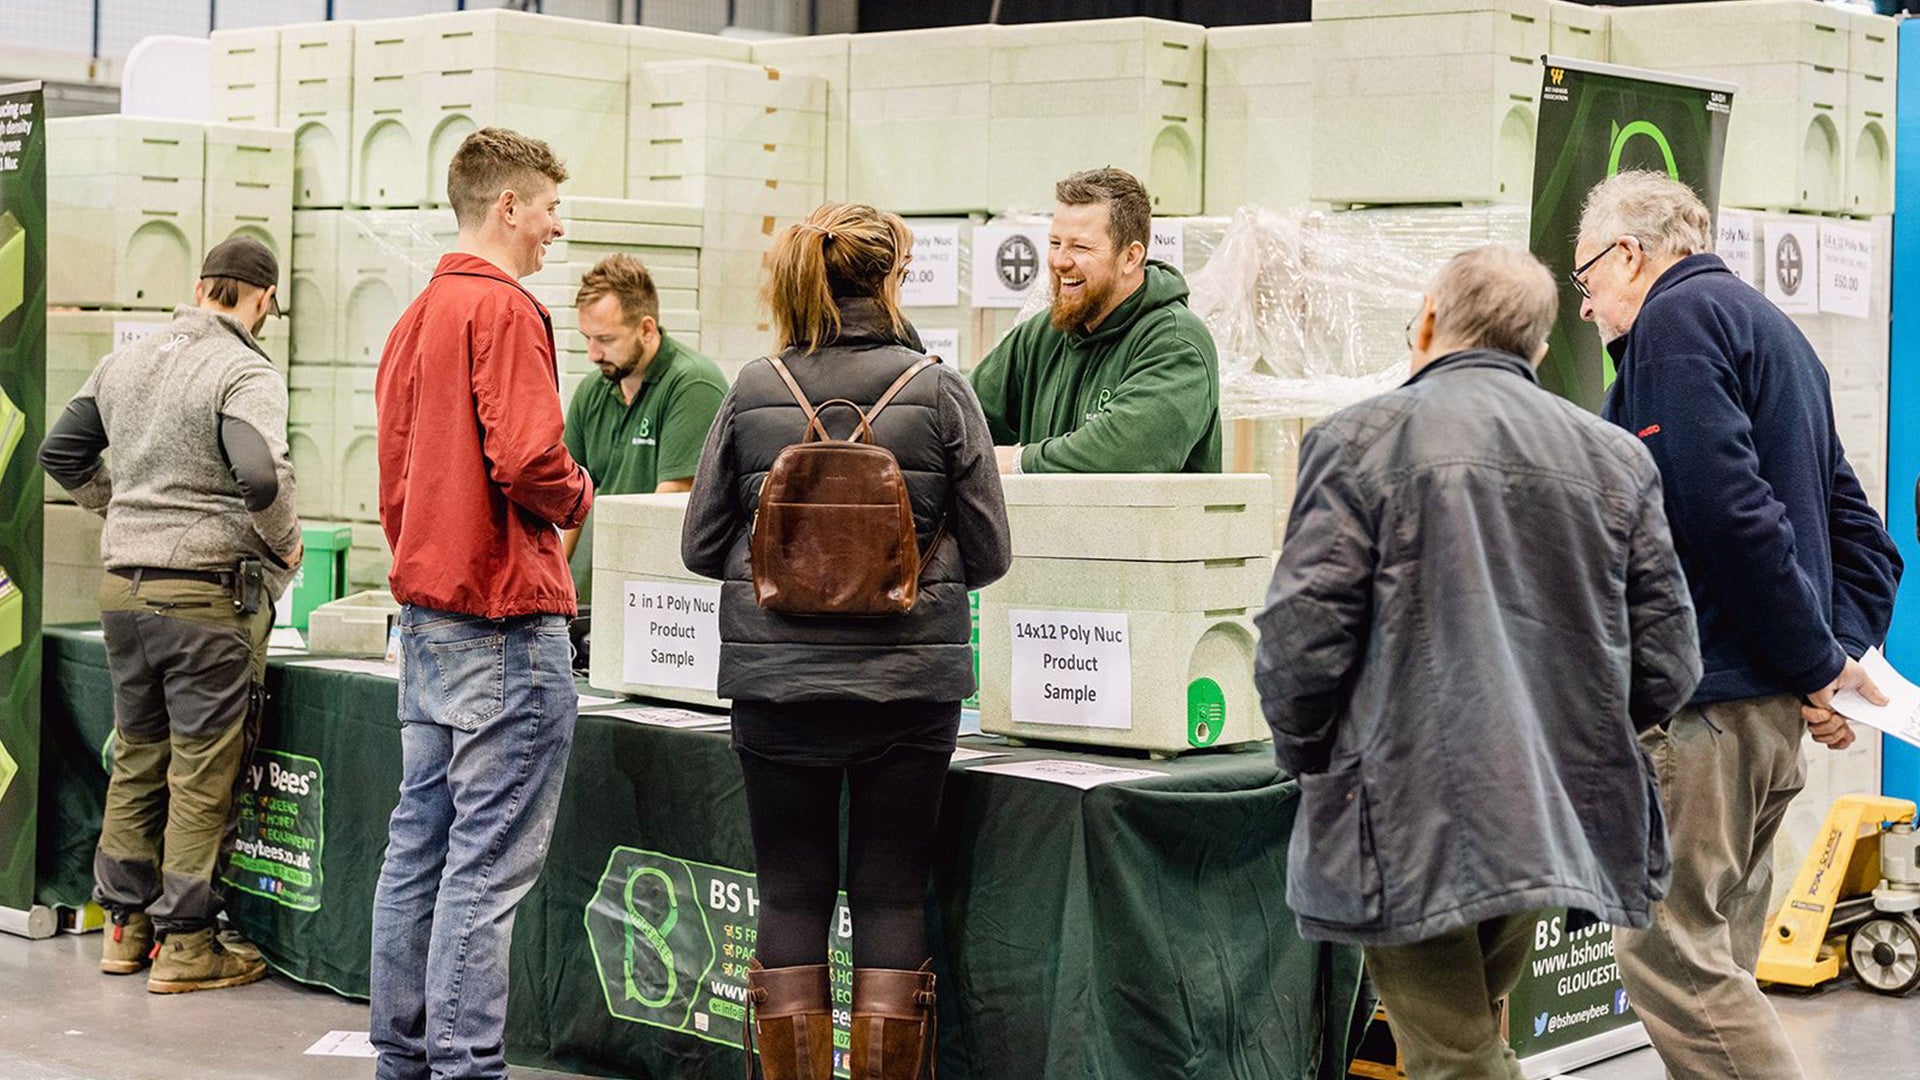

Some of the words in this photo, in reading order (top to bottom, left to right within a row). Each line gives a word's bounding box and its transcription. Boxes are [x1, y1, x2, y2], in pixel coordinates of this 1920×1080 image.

[20, 103, 33, 115] our
[6, 119, 32, 136] density
[4, 156, 18, 170] Nuc
[934, 236, 952, 246] Nuc
[1154, 234, 1175, 245] Nuc
[906, 270, 934, 283] 0.00
[629, 592, 636, 607] 2
[642, 593, 653, 608] in
[657, 594, 663, 609] 1
[667, 595, 691, 614] Poly
[693, 597, 715, 613] Nuc
[650, 621, 695, 639] Product
[1016, 622, 1057, 640] 14x12
[1060, 624, 1090, 645] Poly
[1094, 625, 1122, 643] Nuc
[651, 648, 695, 668] Sample
[1043, 653, 1098, 672] Product
[1044, 682, 1097, 705] Sample
[710, 878, 741, 913] BS
[838, 906, 853, 938] B
[735, 926, 742, 940] 5
[745, 927, 757, 943] FR
[1535, 916, 1561, 951] BS
[1547, 1003, 1610, 1033] @bshoneybees
